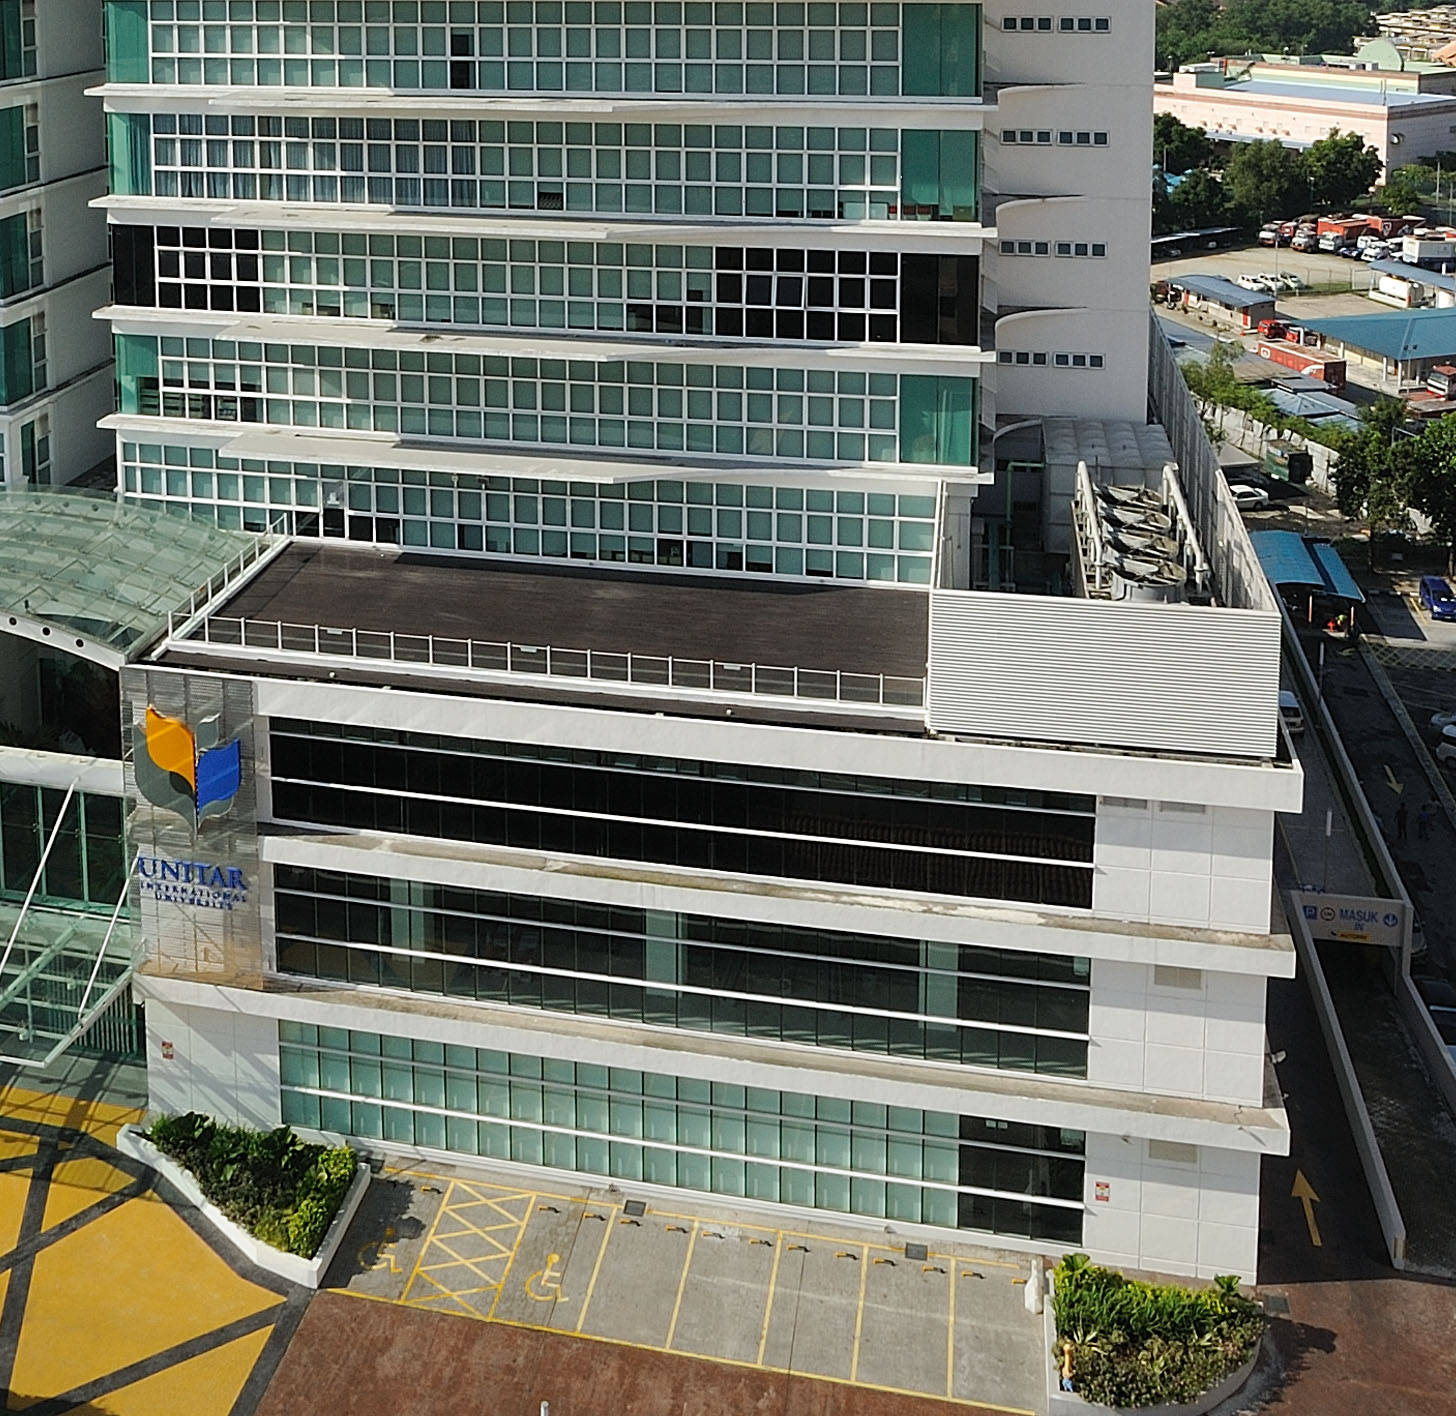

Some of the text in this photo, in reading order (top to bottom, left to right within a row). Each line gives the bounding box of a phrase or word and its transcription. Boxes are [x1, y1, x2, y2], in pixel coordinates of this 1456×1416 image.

[138, 856, 248, 890] UNITAR
[141, 880, 248, 902] INTERNATIONAL
[155, 891, 233, 910] UNIVERSITY
[1340, 908, 1378, 924] MASUK
